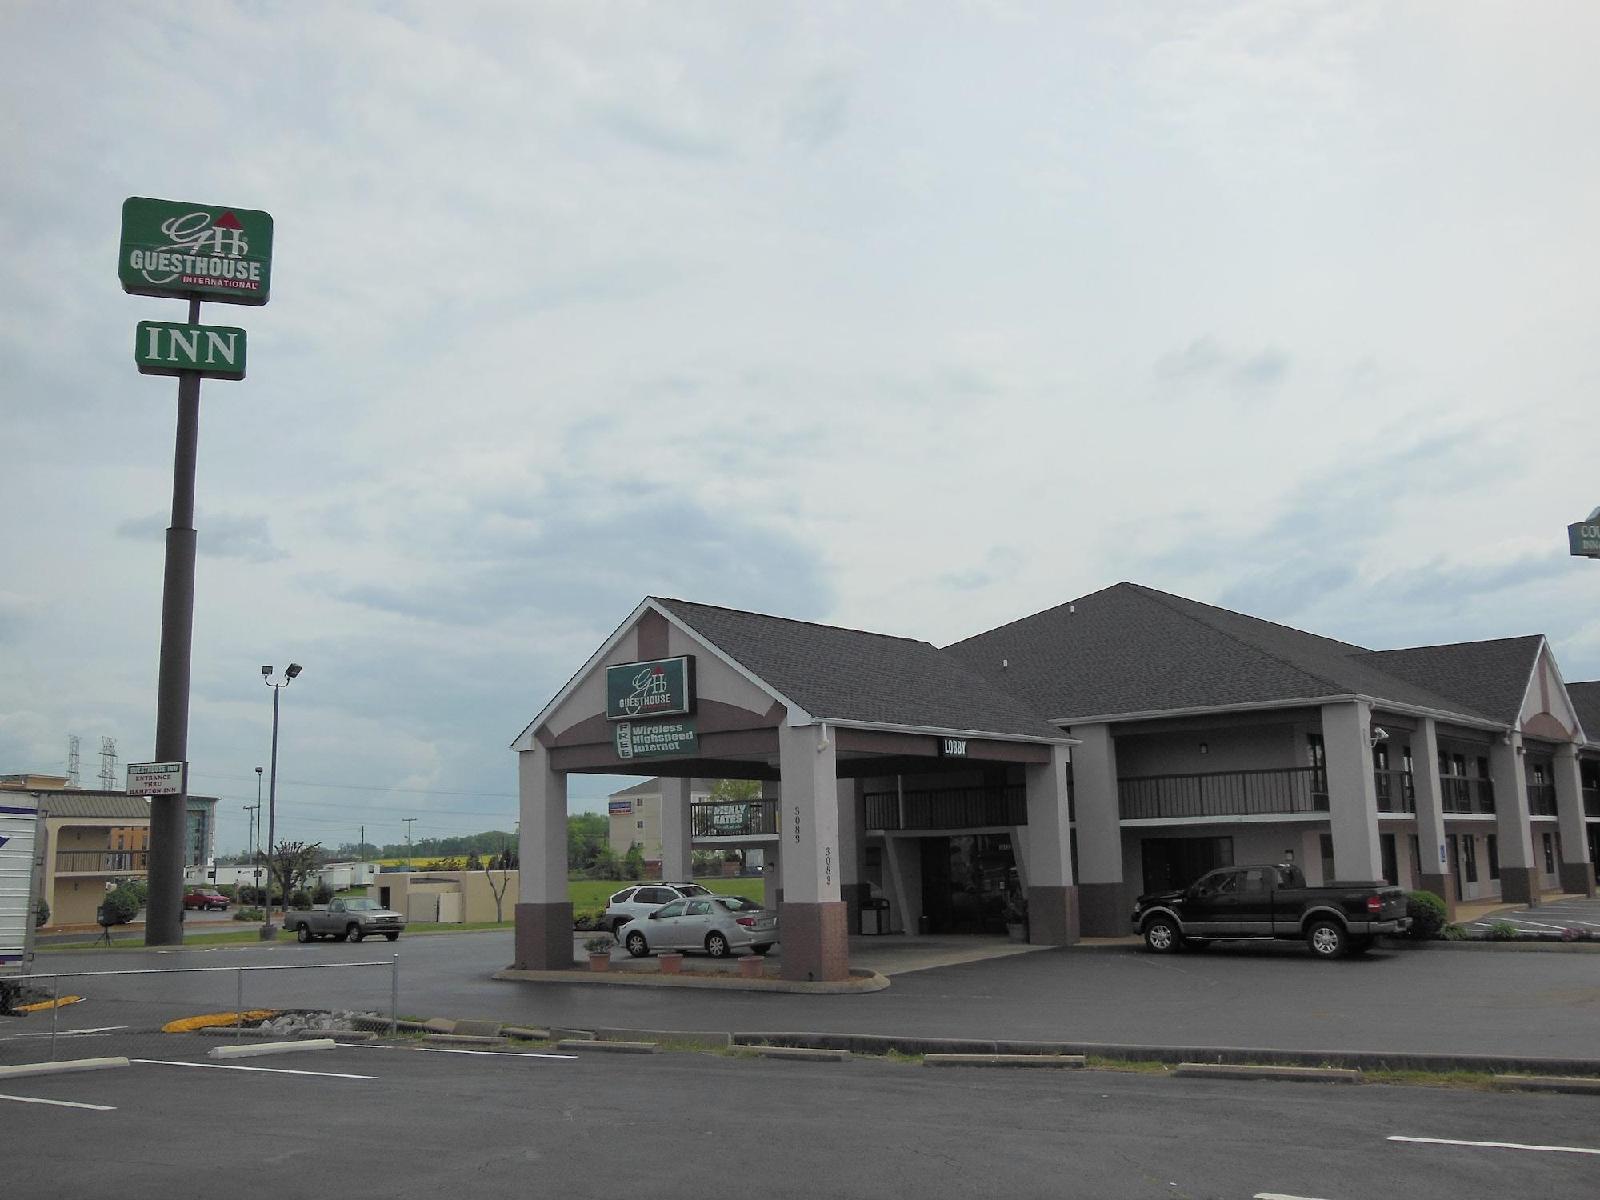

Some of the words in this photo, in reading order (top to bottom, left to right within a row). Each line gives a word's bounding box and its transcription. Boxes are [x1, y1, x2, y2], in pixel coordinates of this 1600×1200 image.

[130, 250, 261, 282] GUESTHOUSE
[182, 275, 258, 291] INTERNATIONAL
[145, 327, 238, 365] INN
[619, 693, 671, 708] GUESTHOUSE
[632, 724, 683, 736] Wireless
[632, 731, 694, 744] Highspeed
[633, 741, 680, 753] Internet
[945, 739, 966, 755] LOBBY
